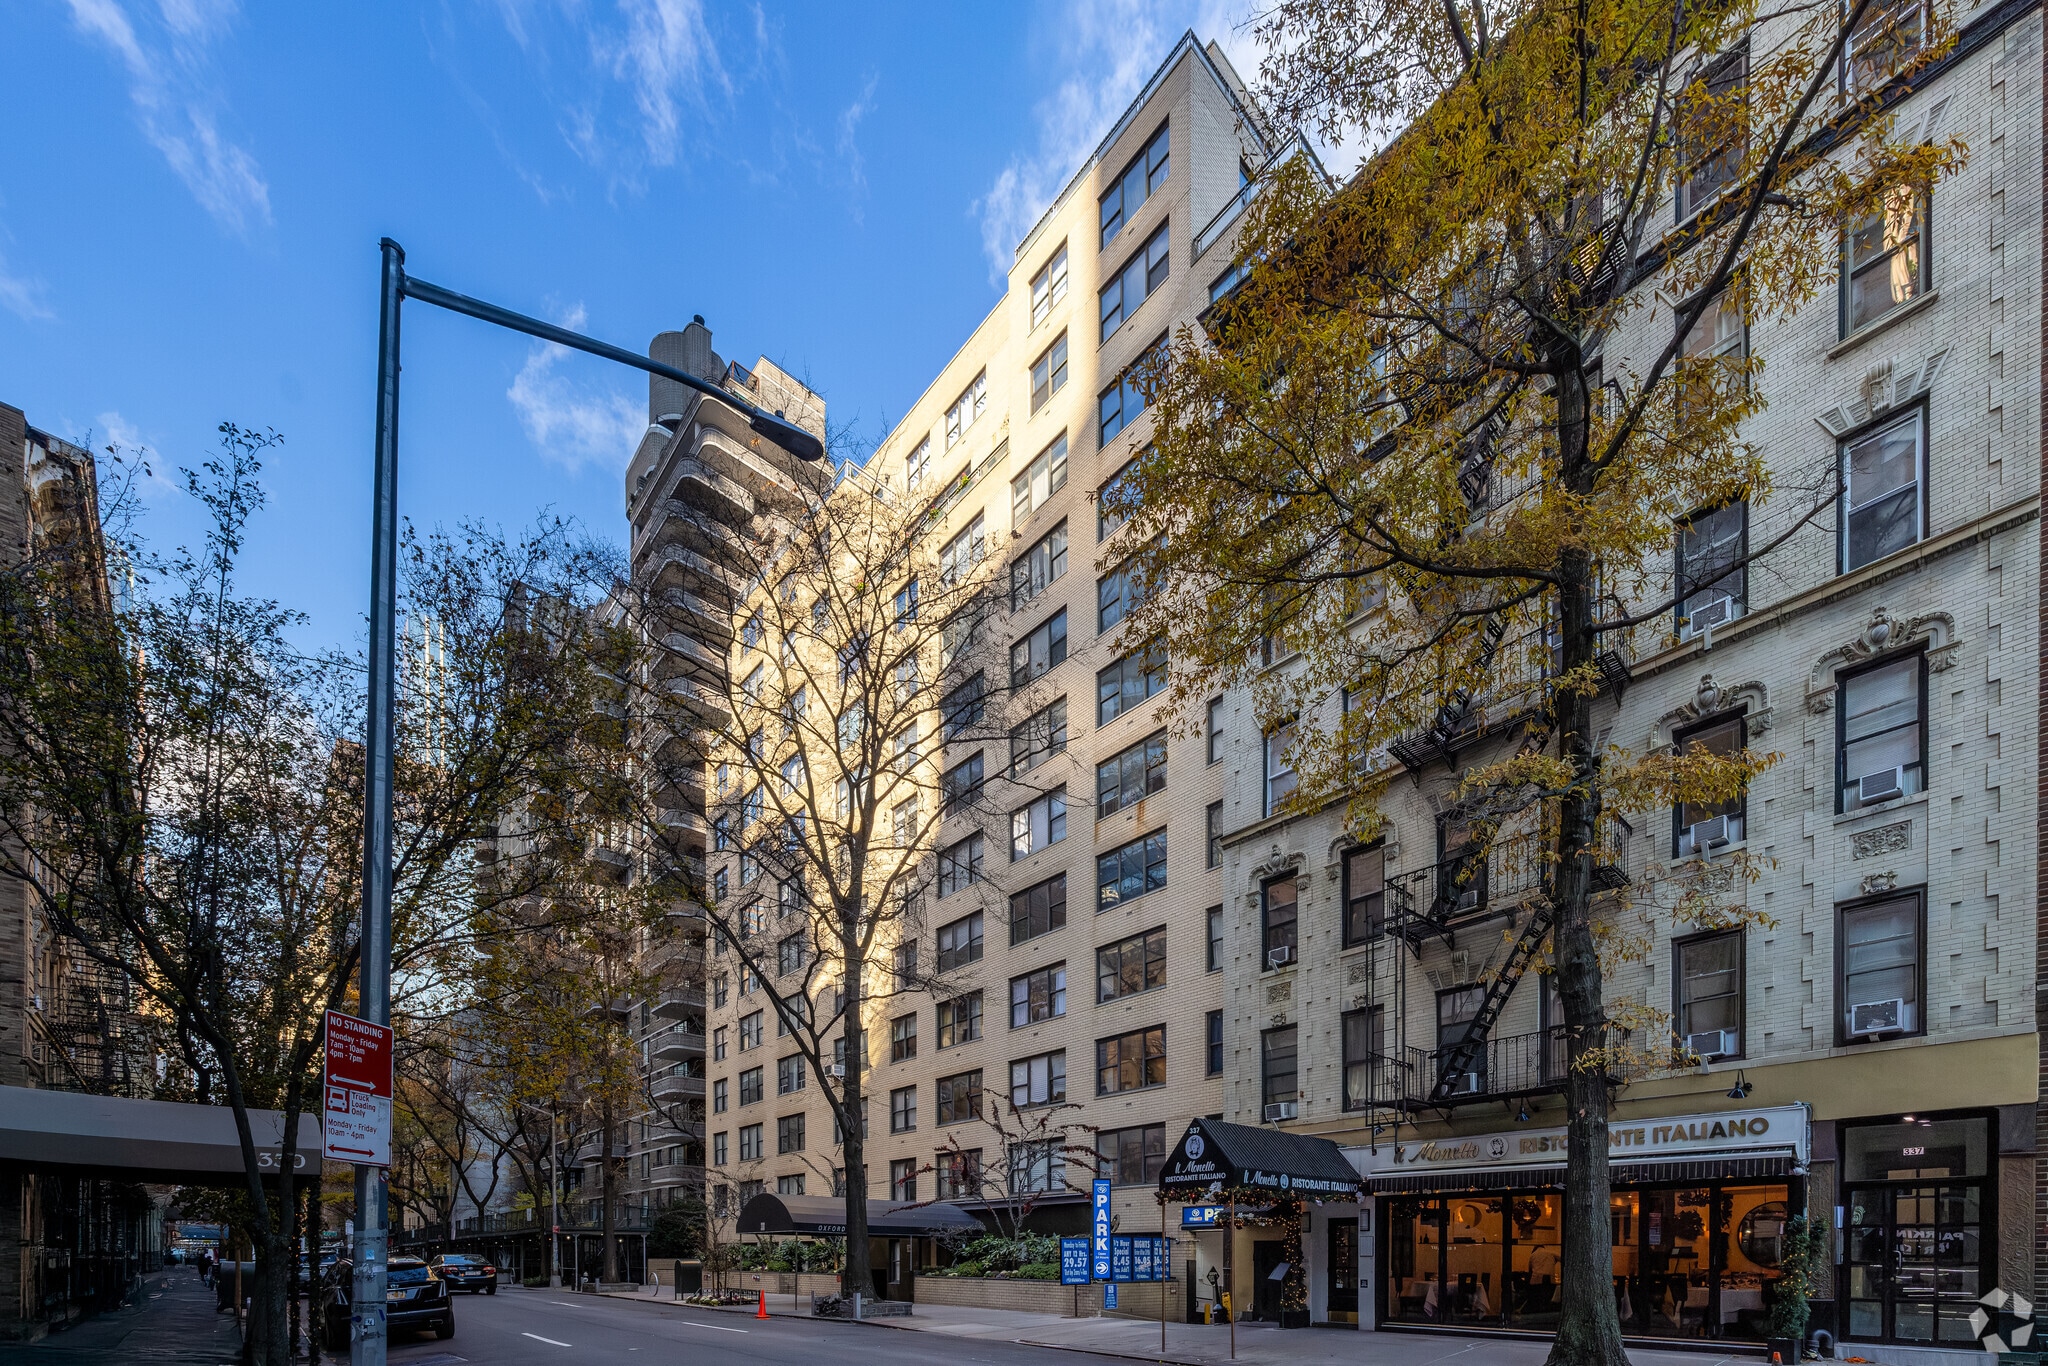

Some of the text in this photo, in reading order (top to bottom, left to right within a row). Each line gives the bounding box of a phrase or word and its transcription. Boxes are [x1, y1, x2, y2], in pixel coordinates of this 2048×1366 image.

[330, 1016, 383, 1038] NO STANDING
[330, 1030, 354, 1044] Monday
[360, 1038, 378, 1051] Friday
[330, 1039, 344, 1049] 7am
[350, 1045, 365, 1054] 10am
[330, 1049, 344, 1058] 4pm
[349, 1053, 362, 1062] 7pm
[352, 1092, 369, 1102] Truck
[352, 1100, 376, 1112] Loading
[352, 1108, 365, 1118] Only
[328, 1118, 352, 1130] Monday
[358, 1124, 377, 1134] Friday
[328, 1128, 345, 1136] 10am
[351, 1131, 365, 1140] 4pm
[1408, 1141, 1480, 1163] Monello
[1519, 1128, 1646, 1154] RISTNTE
[1652, 1117, 1770, 1144] ITALIANO
[1904, 1147, 1923, 1155] 337
[1182, 1160, 1216, 1173] Monello
[1165, 1172, 1226, 1183] RISTORANTE ITALIANO
[1250, 1170, 1278, 1186] Monello
[1292, 1178, 1330, 1190] RISTORANTE
[1330, 1182, 1358, 1193] ITALIANO
[1096, 1194, 1108, 1250] PARK
[1134, 1240, 1150, 1248] NIGHTS
[1114, 1247, 1129, 1256] Special
[1064, 1258, 1087, 1267] 29.57
[1113, 1256, 1130, 1266] 8.45
[1134, 1256, 1150, 1264] 16.05
